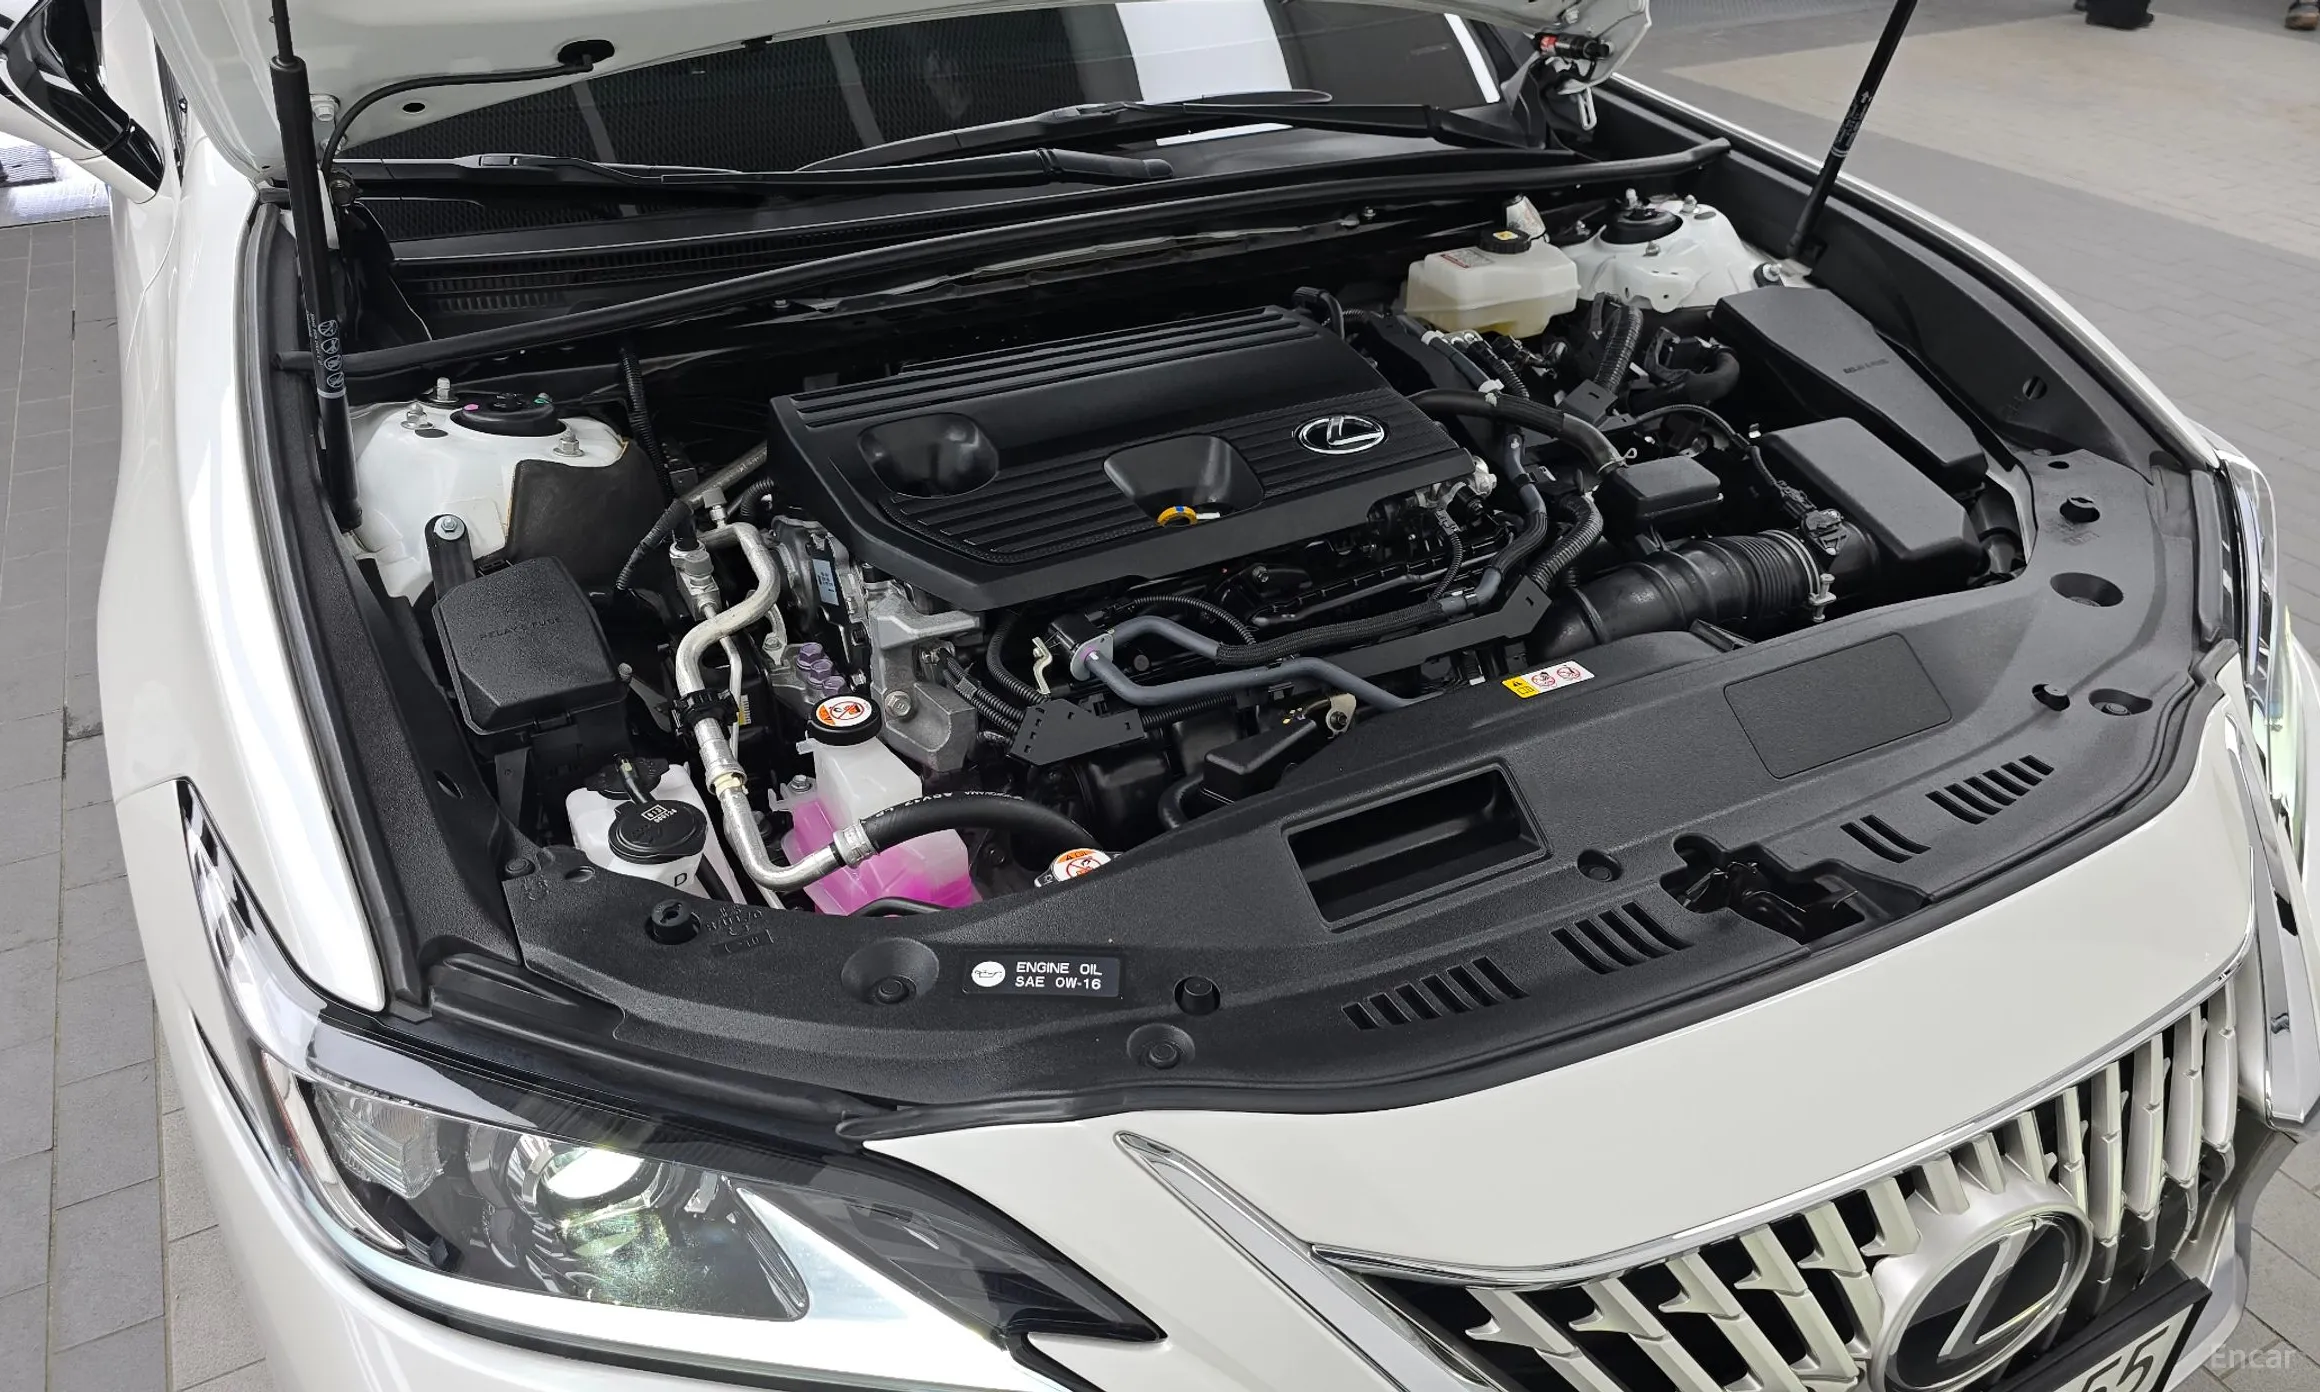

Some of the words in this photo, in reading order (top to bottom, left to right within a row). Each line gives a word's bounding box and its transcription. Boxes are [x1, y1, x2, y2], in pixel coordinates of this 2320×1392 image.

[1016, 961, 1070, 974] ENGINE
[1079, 963, 1103, 976] OIL
[1014, 975, 1046, 988] SAE
[1055, 976, 1102, 990] 0W-16
